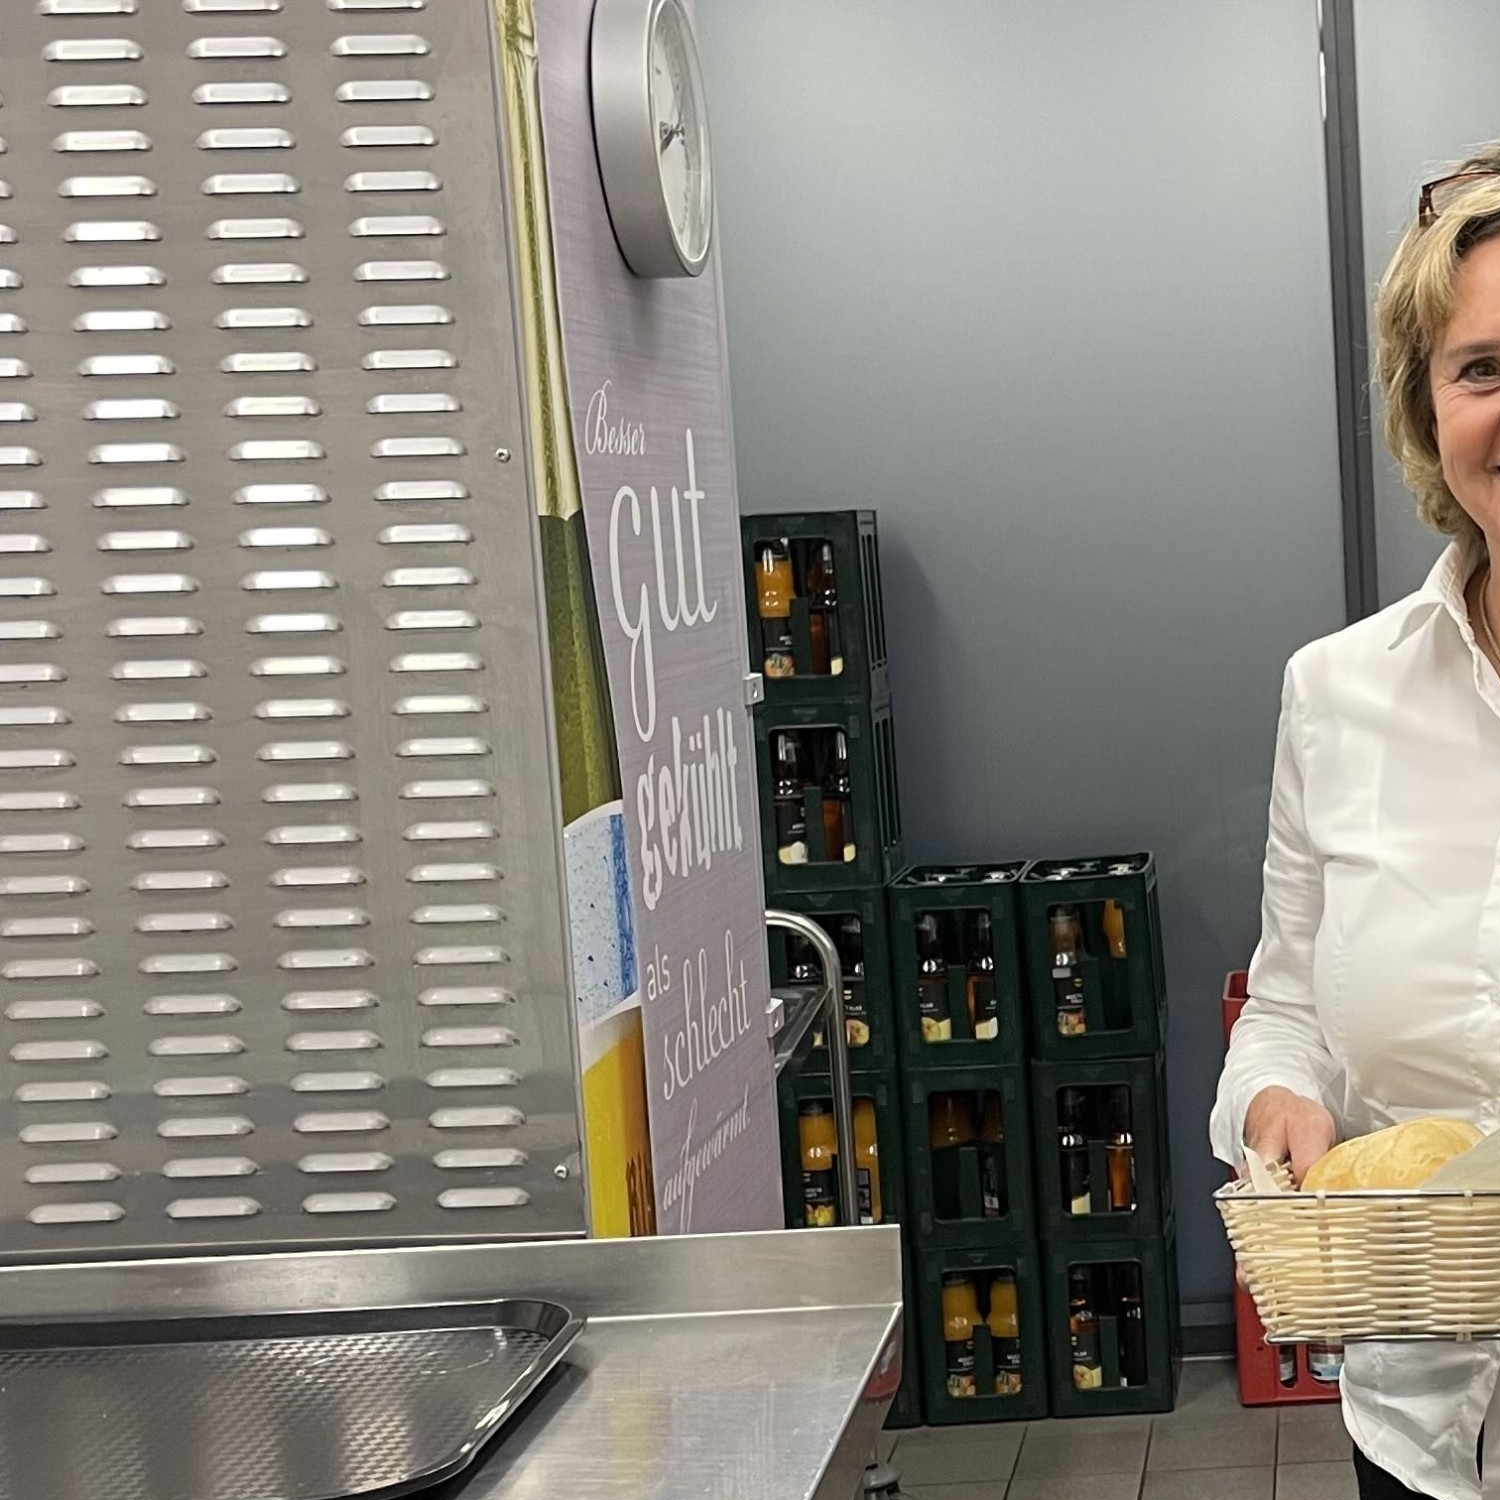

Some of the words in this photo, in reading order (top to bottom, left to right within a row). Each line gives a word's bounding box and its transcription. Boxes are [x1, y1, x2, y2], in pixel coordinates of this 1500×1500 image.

[585, 380, 647, 456] Besser
[609, 428, 718, 742] gut
[646, 943, 671, 1001] als
[663, 929, 751, 1101] schlecht
